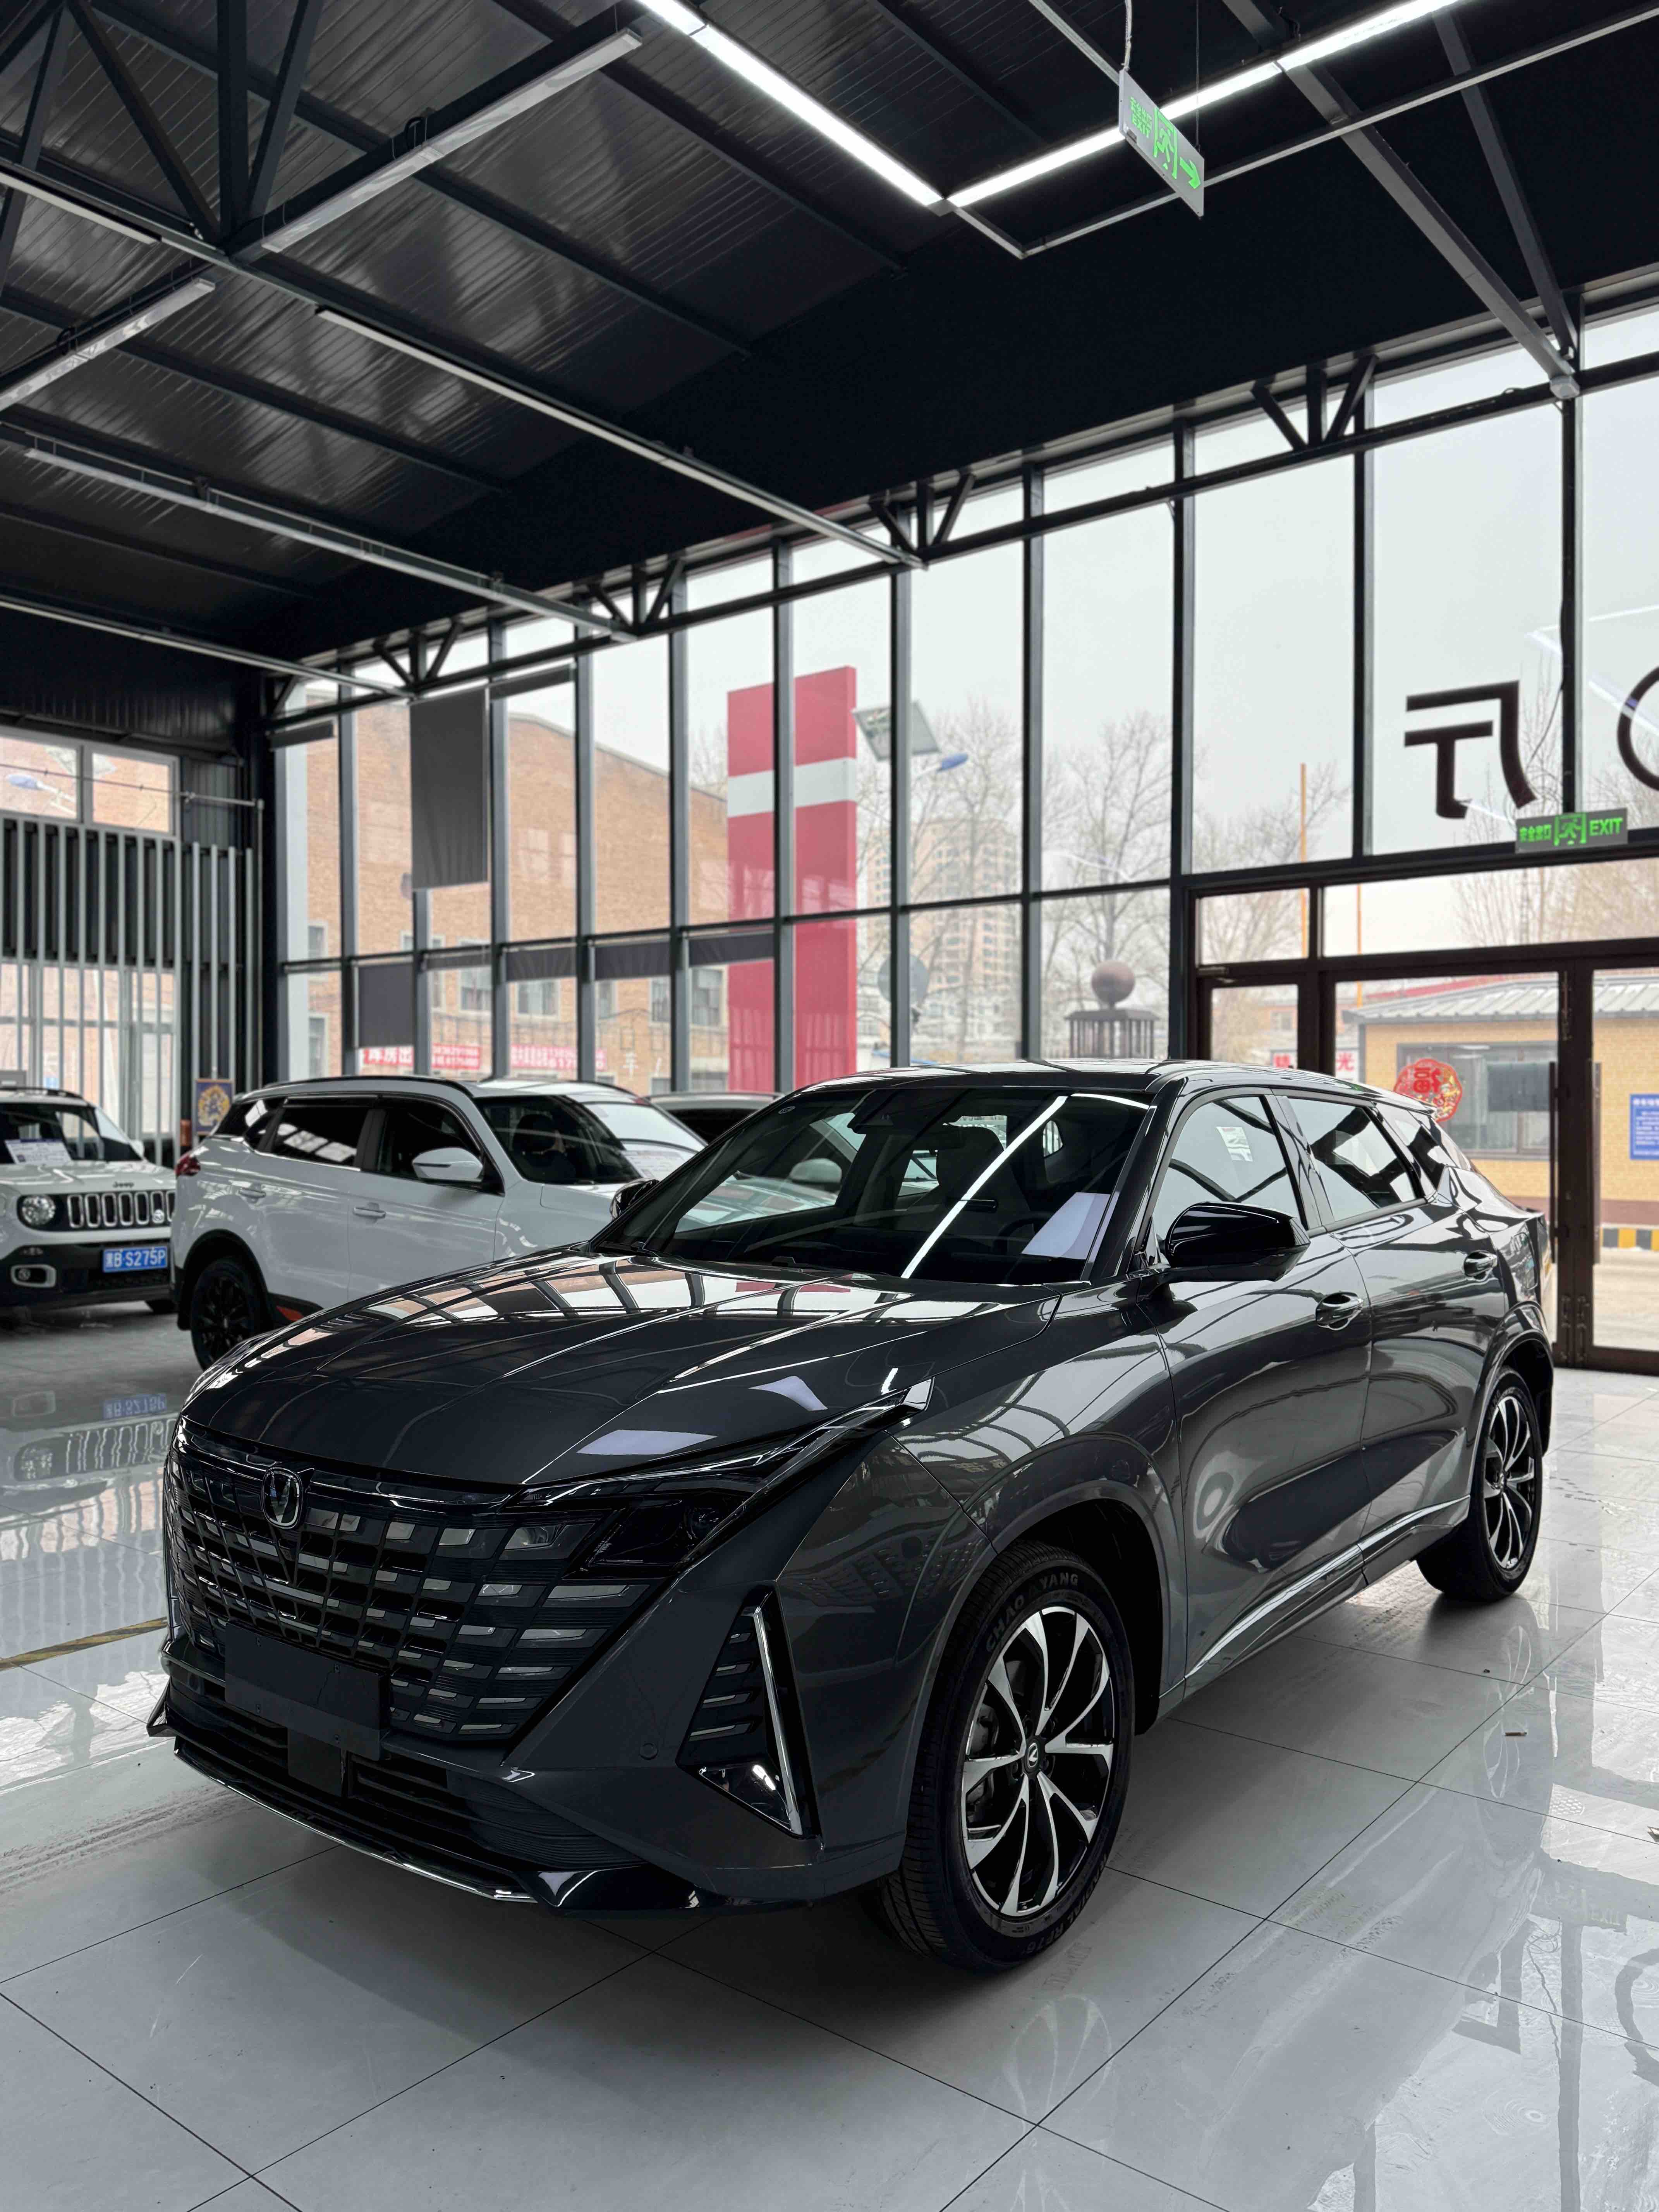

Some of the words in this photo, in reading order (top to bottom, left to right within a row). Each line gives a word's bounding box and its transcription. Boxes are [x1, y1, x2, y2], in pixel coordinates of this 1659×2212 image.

[1132, 113, 1151, 138] EXIT
[1589, 817, 1623, 836] EXIT
[986, 1594, 1025, 1652] CHAO
[1039, 1572, 1079, 1590] YANG
